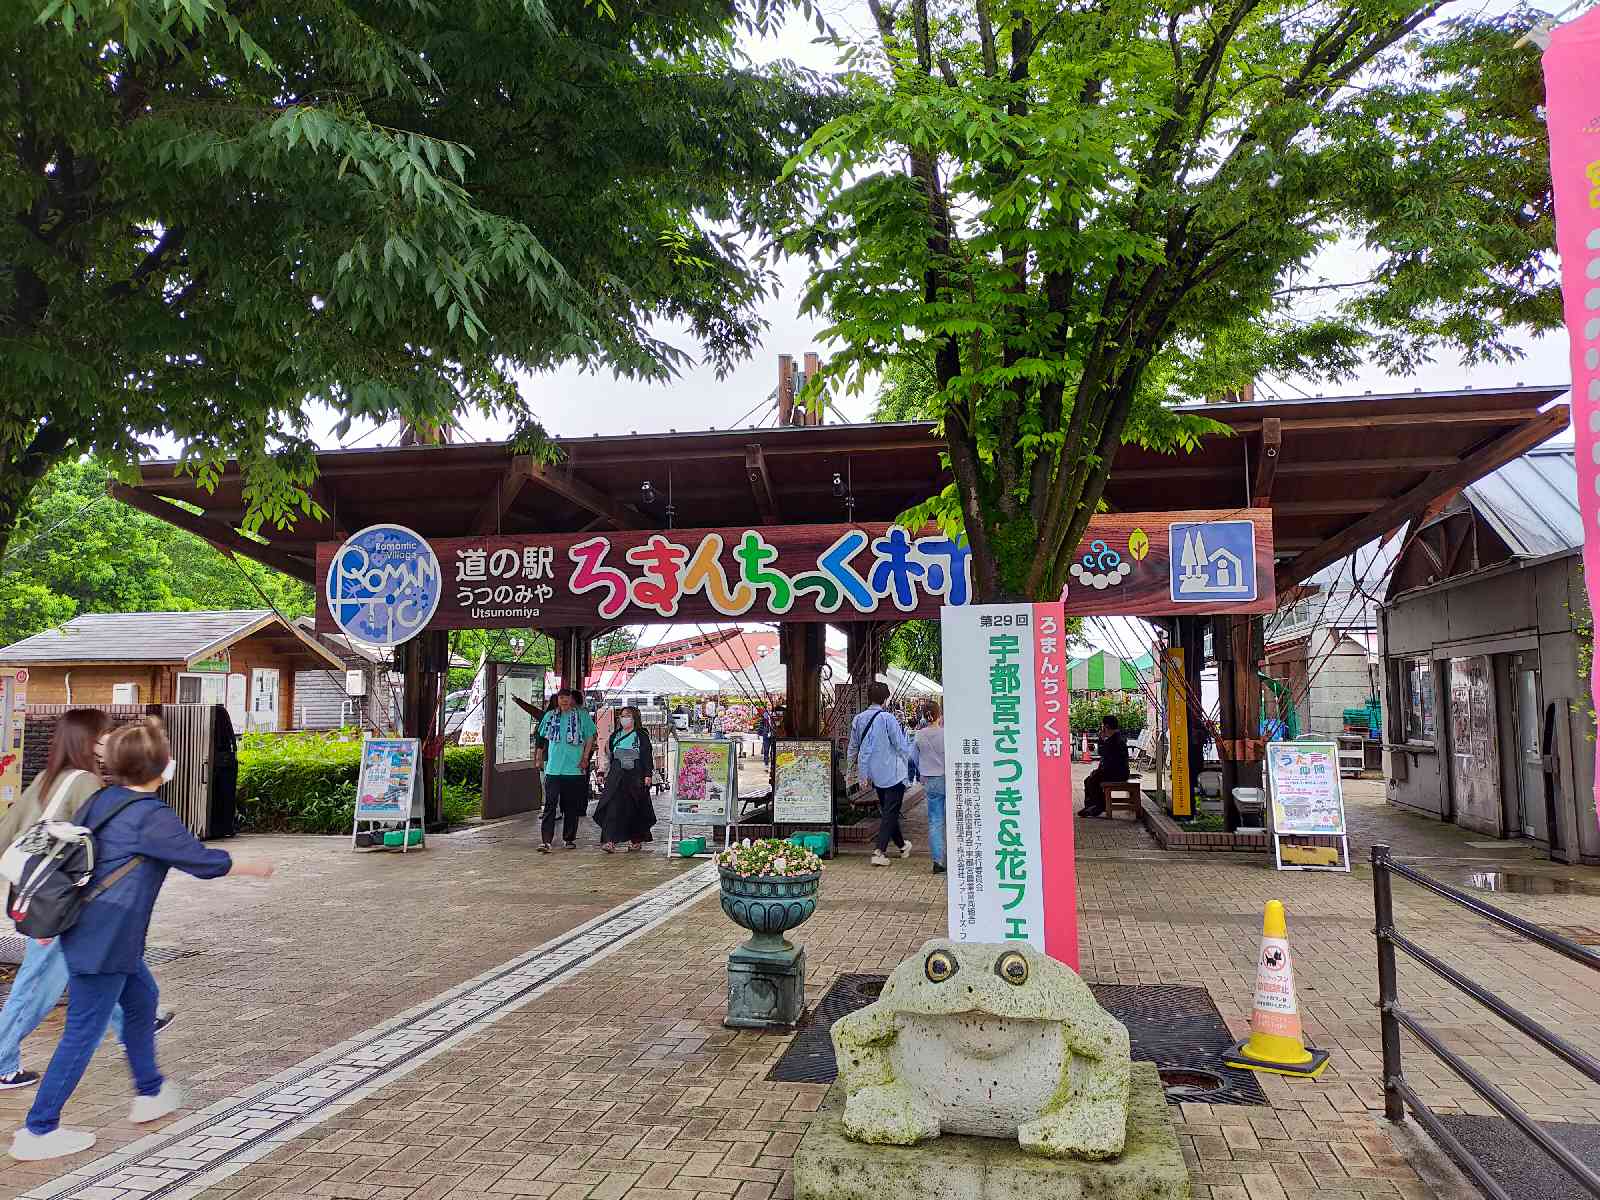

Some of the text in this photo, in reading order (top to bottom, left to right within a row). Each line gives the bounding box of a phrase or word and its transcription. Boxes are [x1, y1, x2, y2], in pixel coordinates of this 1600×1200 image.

[375, 542, 417, 551] Romantic
[384, 551, 417, 561] Village
[455, 547, 555, 582] 道の駅
[569, 524, 972, 620] ろまんちっく村
[456, 584, 553, 607] うつのみや
[471, 606, 540, 618] Utsunomiya
[980, 614, 1029, 628] 第29回
[1039, 616, 1063, 758] ろまんちっく村
